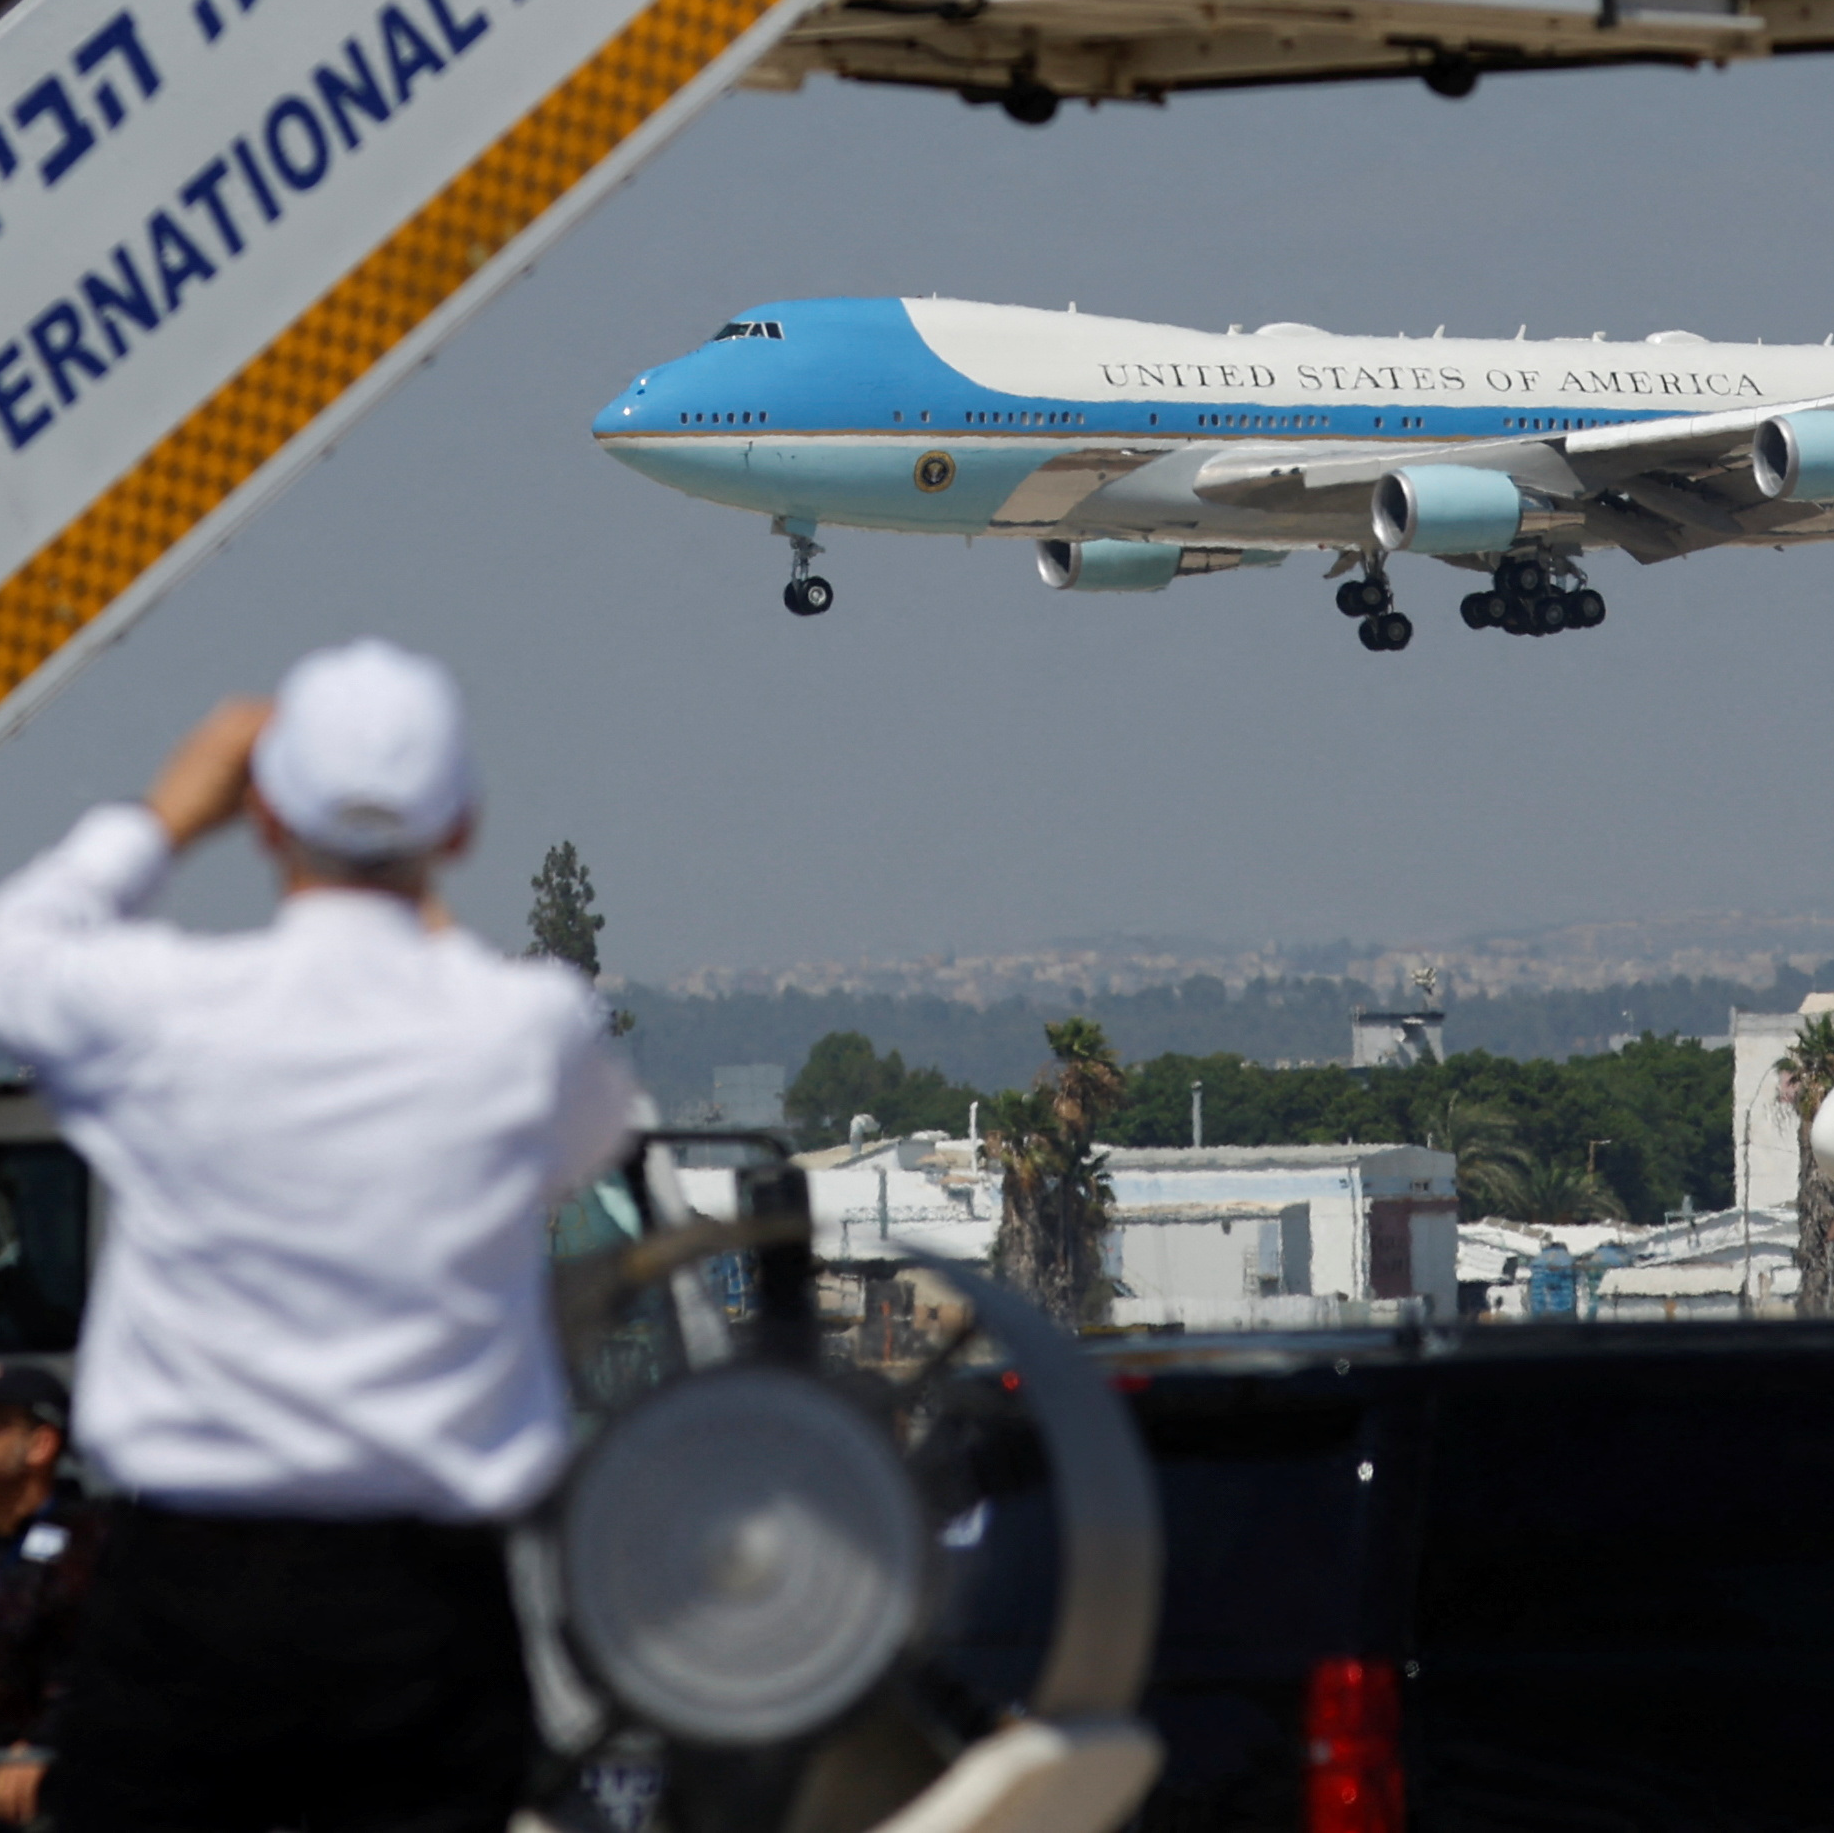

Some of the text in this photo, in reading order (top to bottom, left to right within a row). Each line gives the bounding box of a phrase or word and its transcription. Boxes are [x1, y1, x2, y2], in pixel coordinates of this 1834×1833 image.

[1101, 363, 1766, 397] UNITED STATES OF AMERICA
